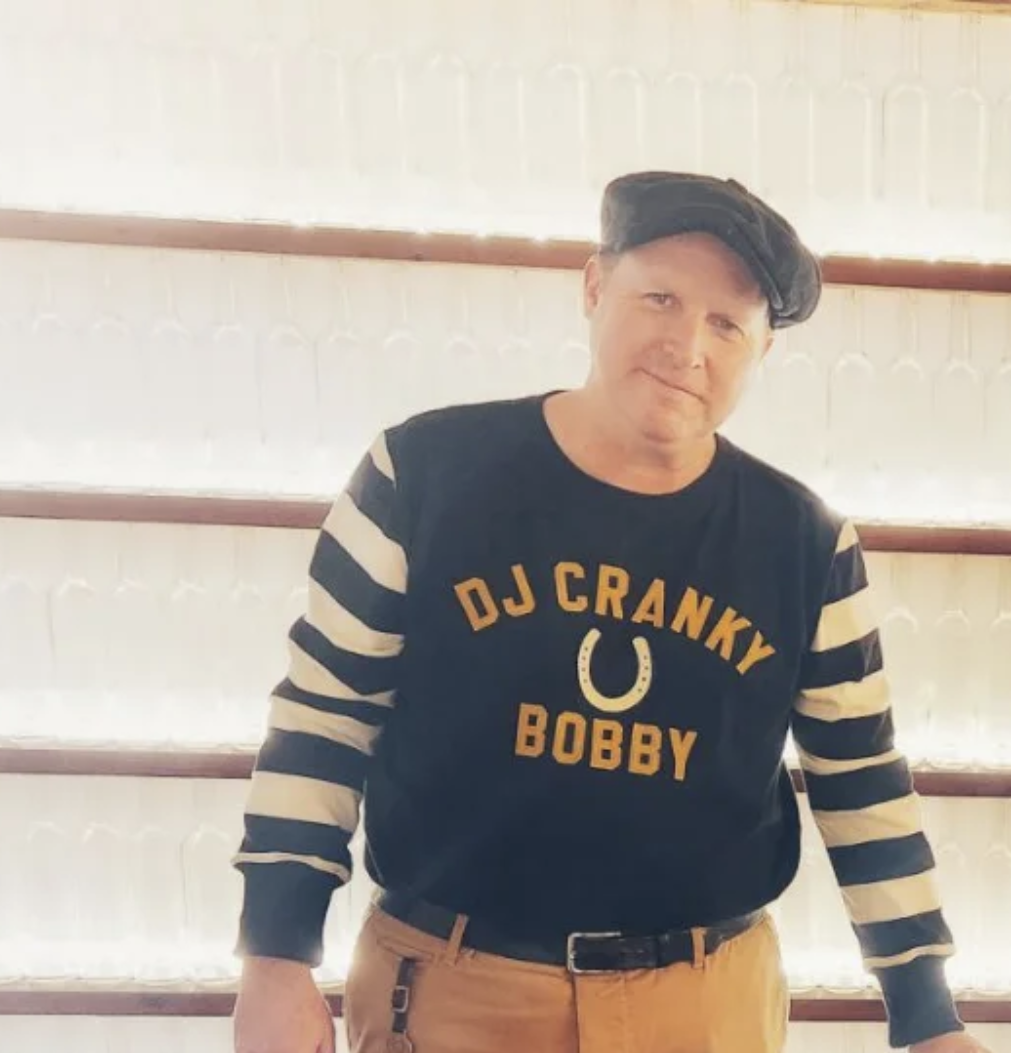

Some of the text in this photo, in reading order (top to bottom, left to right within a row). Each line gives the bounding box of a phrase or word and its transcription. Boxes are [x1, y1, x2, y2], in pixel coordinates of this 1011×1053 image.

[454, 561, 776, 676] DJ CRANKY
[515, 702, 698, 781] BOBBY
